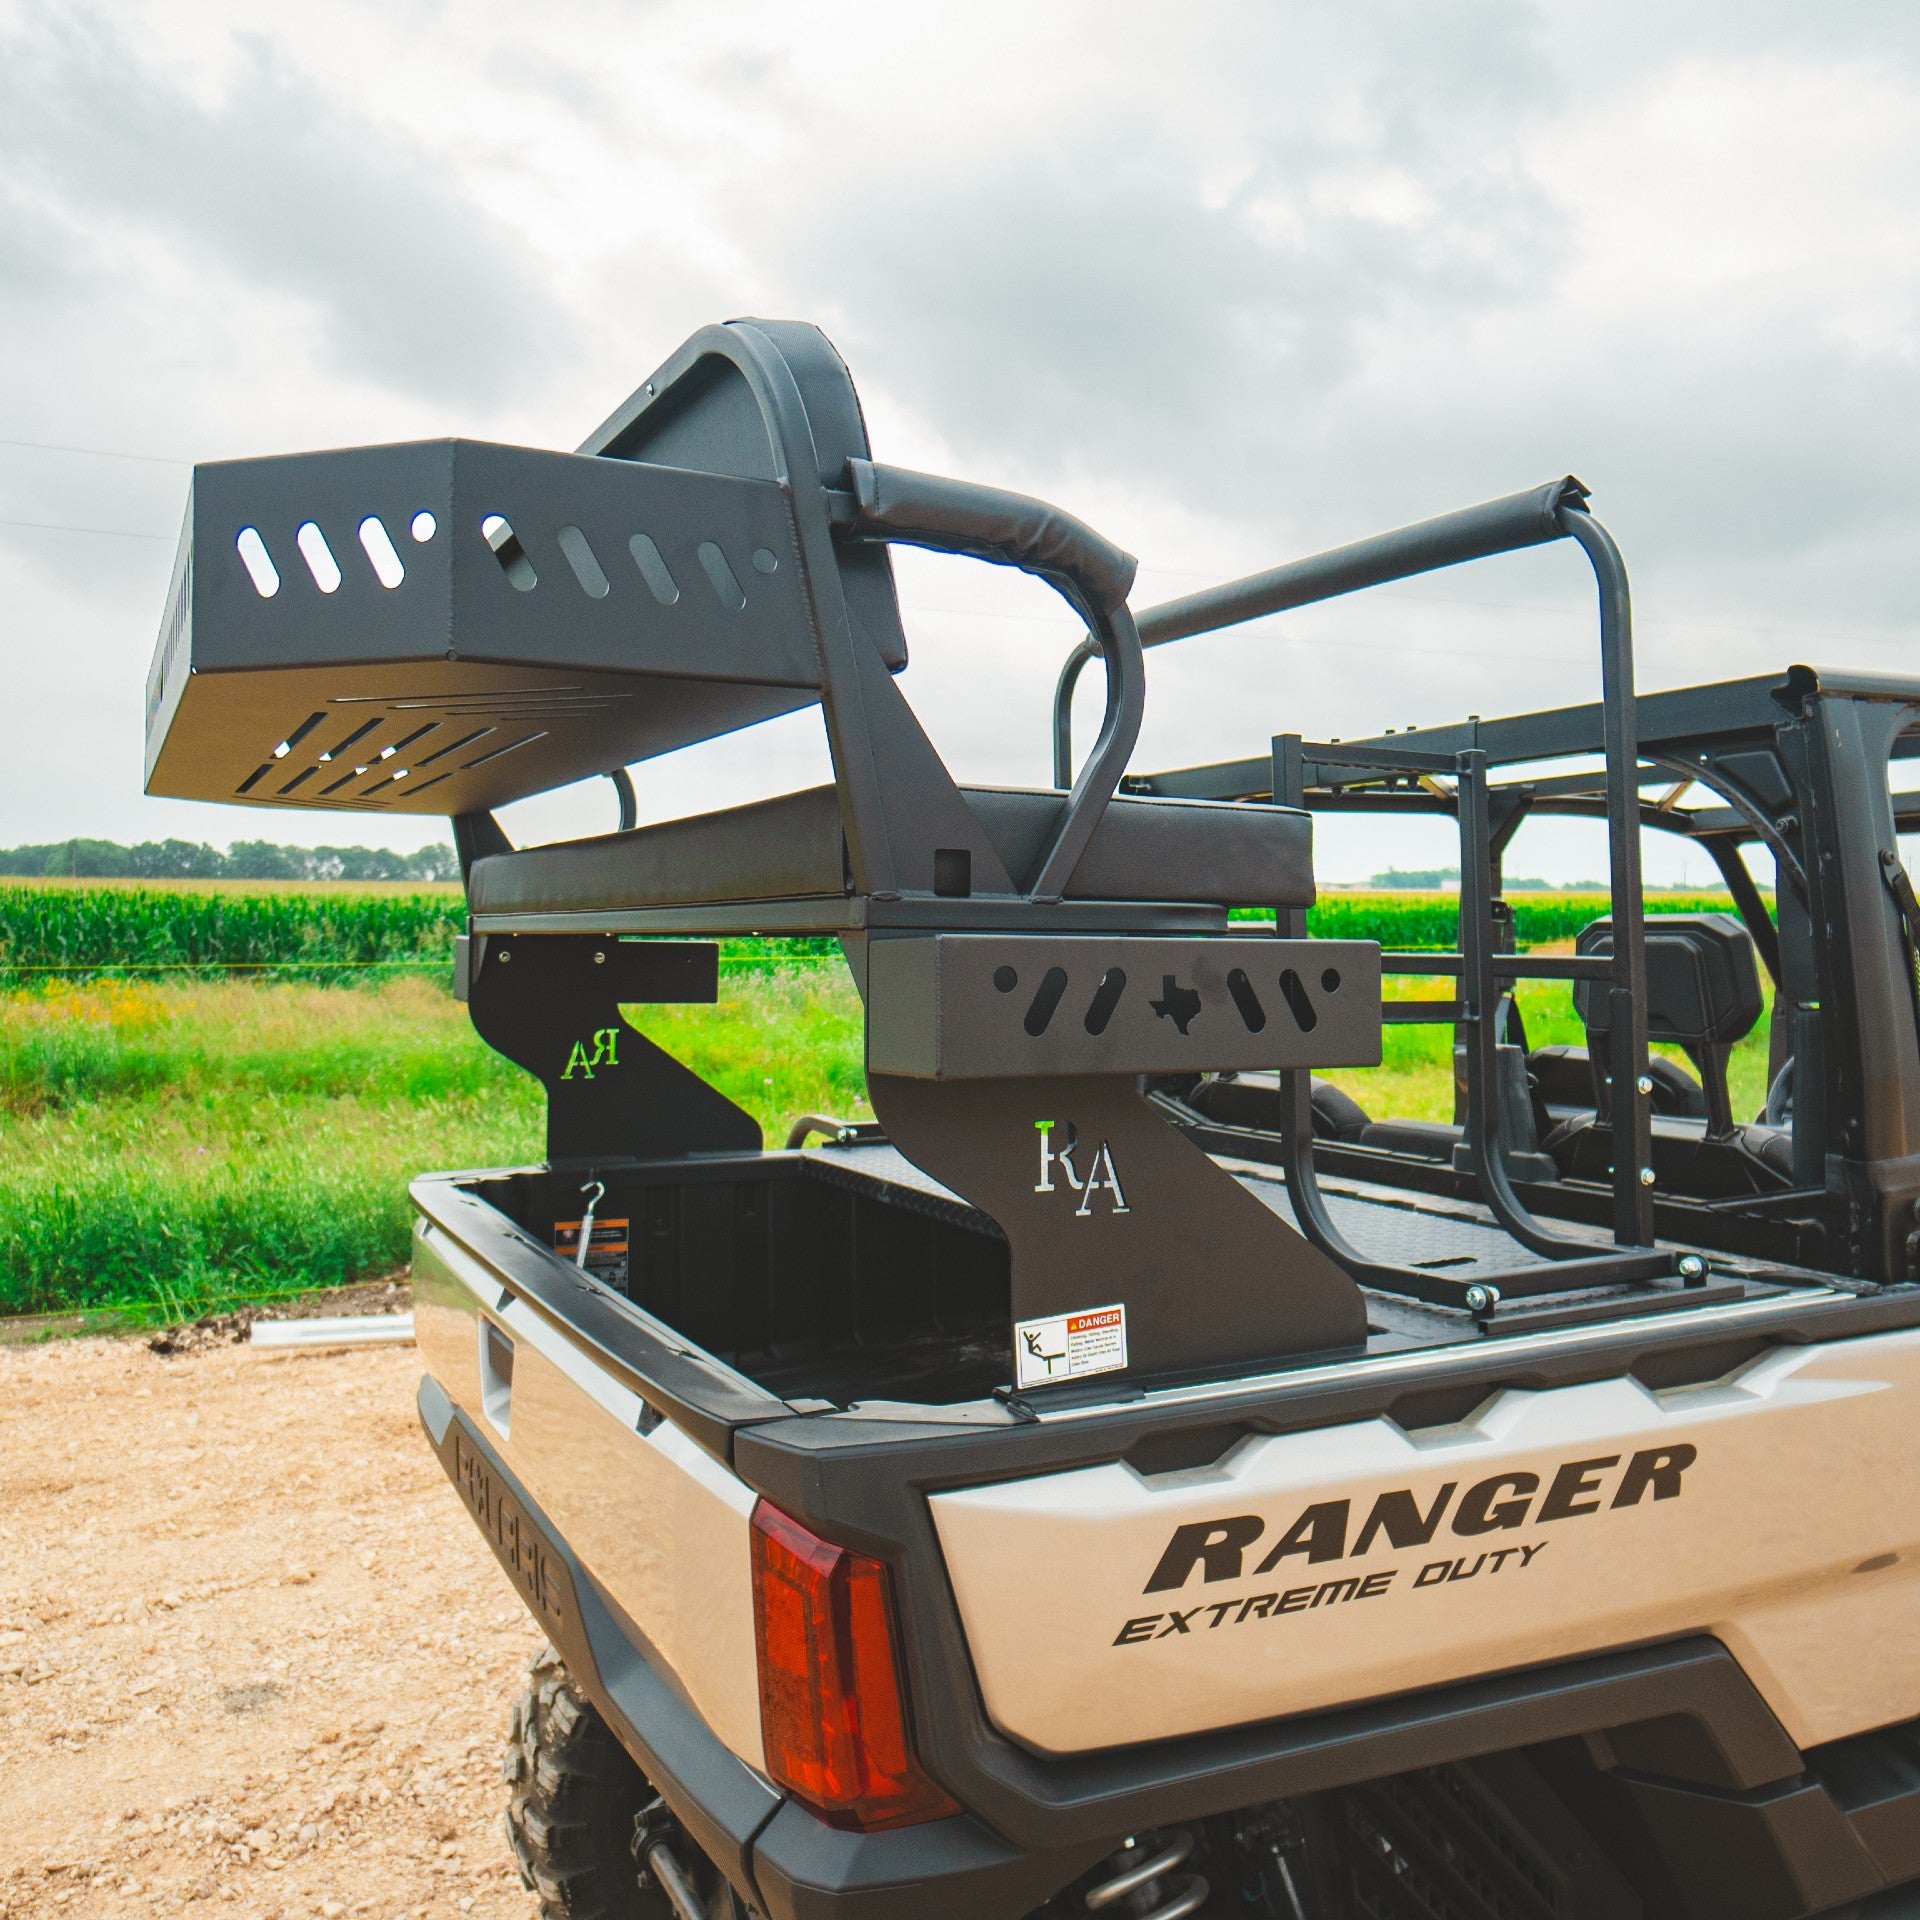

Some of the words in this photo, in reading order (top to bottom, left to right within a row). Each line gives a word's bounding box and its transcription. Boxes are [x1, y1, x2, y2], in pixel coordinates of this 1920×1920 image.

[1034, 1120, 1130, 1216] RA
[1078, 1312, 1120, 1329] DANGER
[1142, 1443, 1698, 1595] RANGER
[1111, 1570, 1398, 1647] EXTREME
[1412, 1541, 1549, 1588] DUTY
